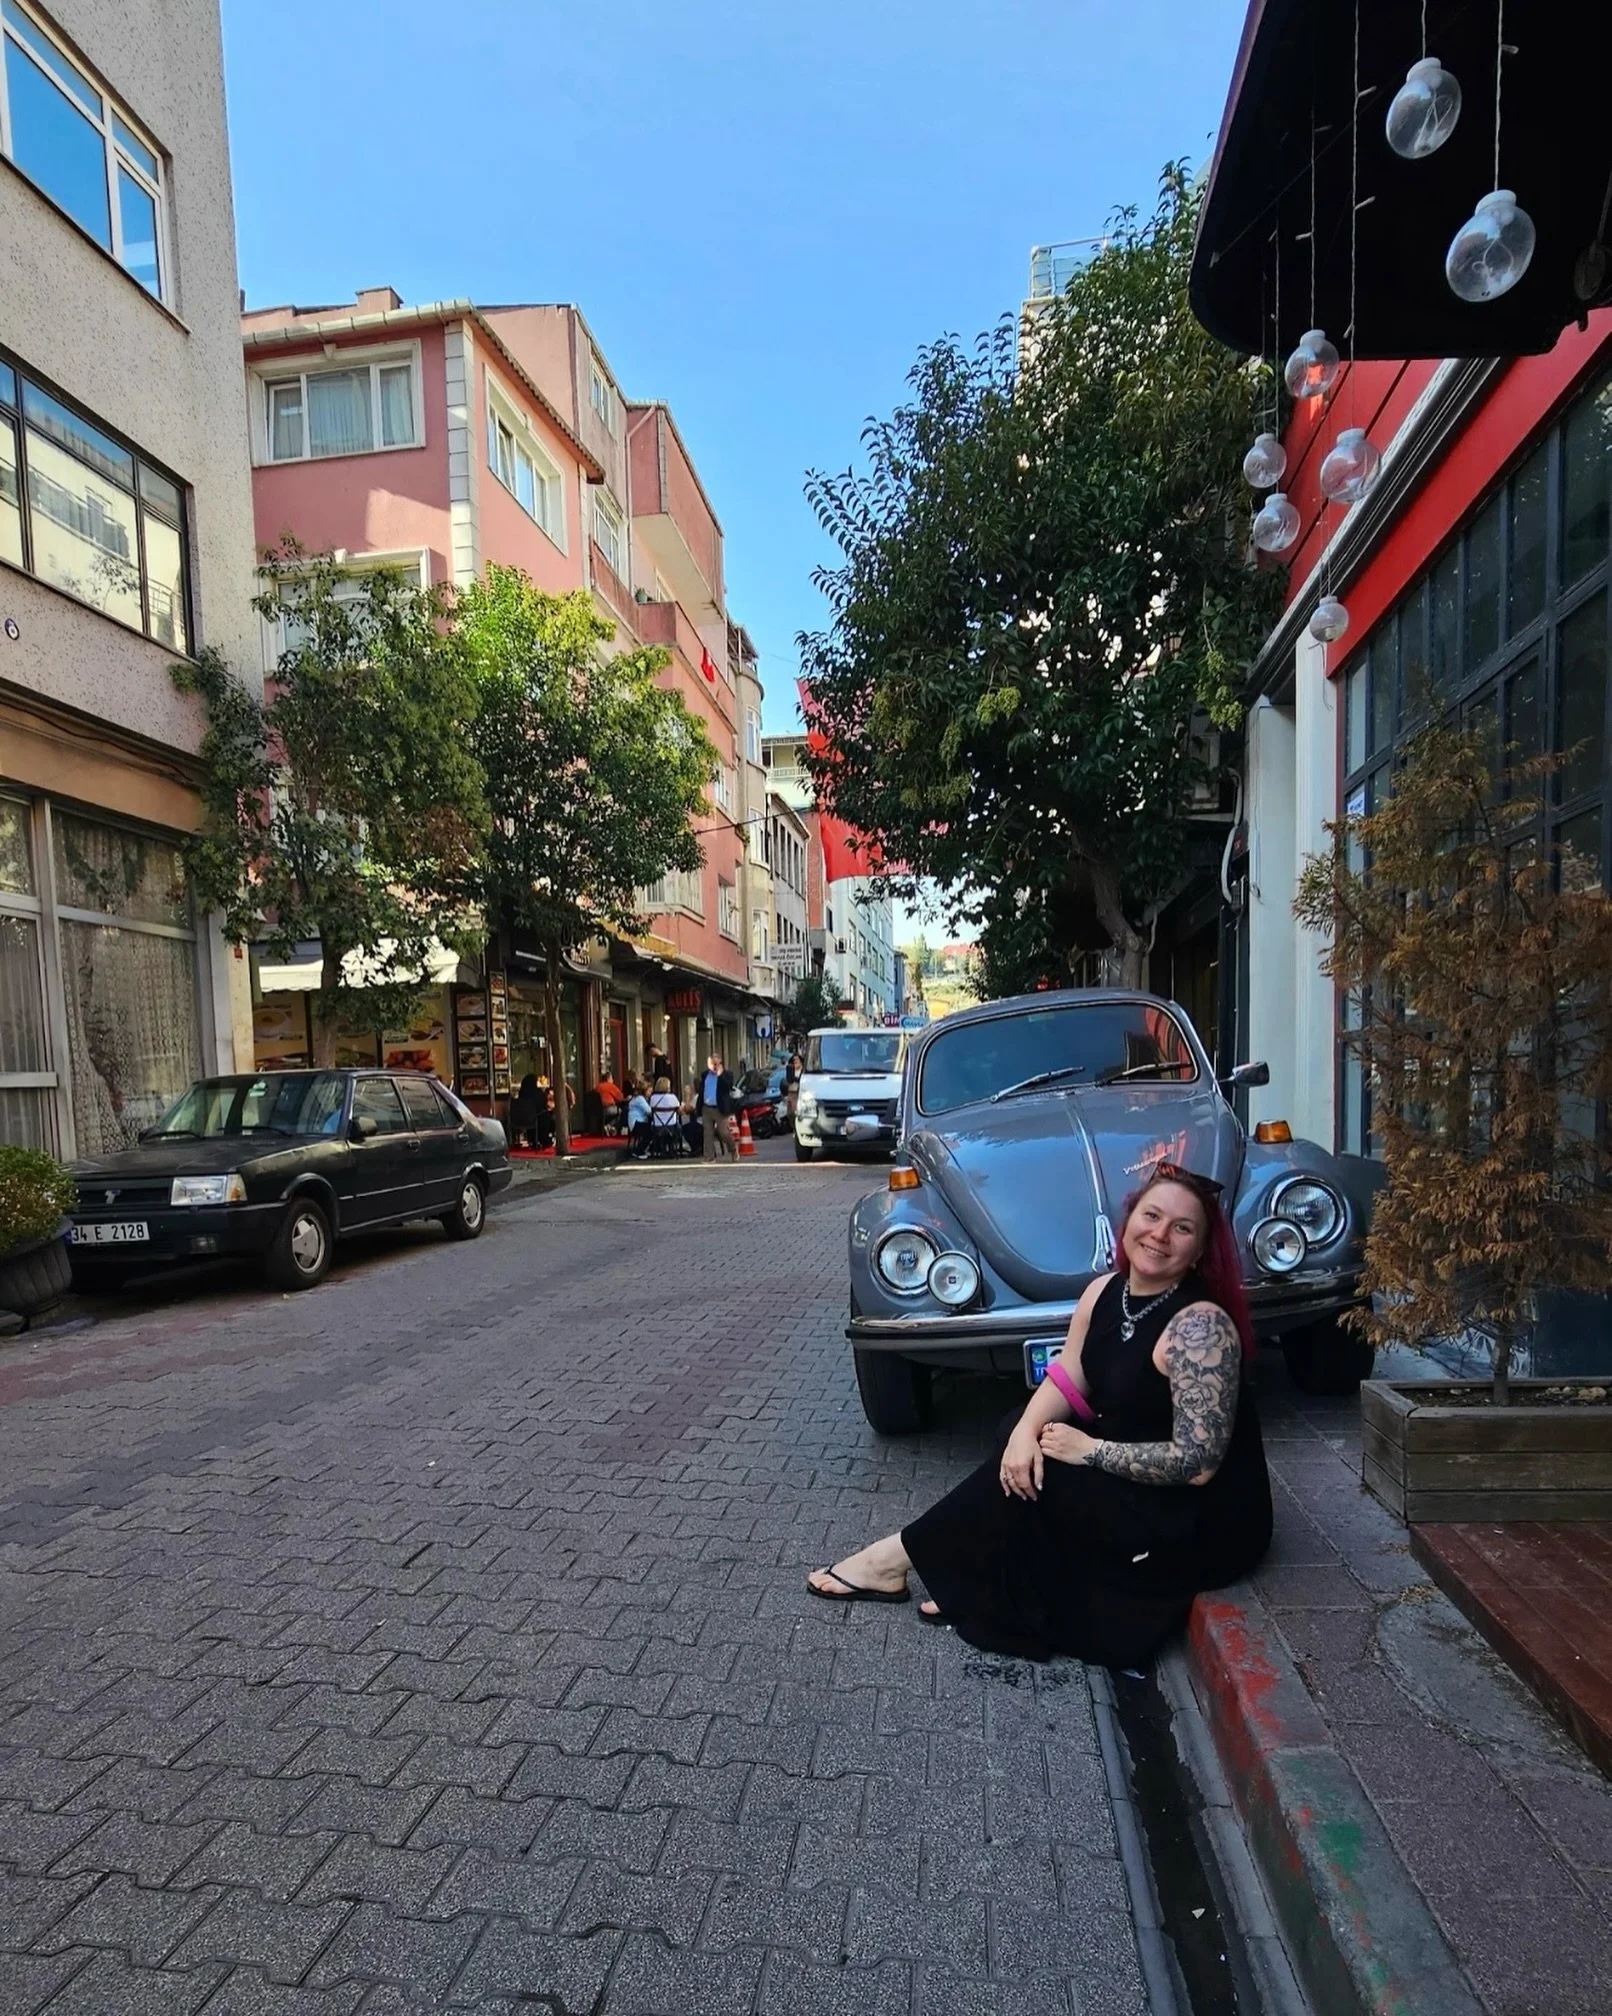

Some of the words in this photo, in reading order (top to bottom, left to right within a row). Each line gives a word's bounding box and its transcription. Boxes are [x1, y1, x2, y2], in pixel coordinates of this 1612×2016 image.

[72, 1227, 87, 1241] 34
[94, 1226, 104, 1240] E
[111, 1224, 145, 1240] 2128
